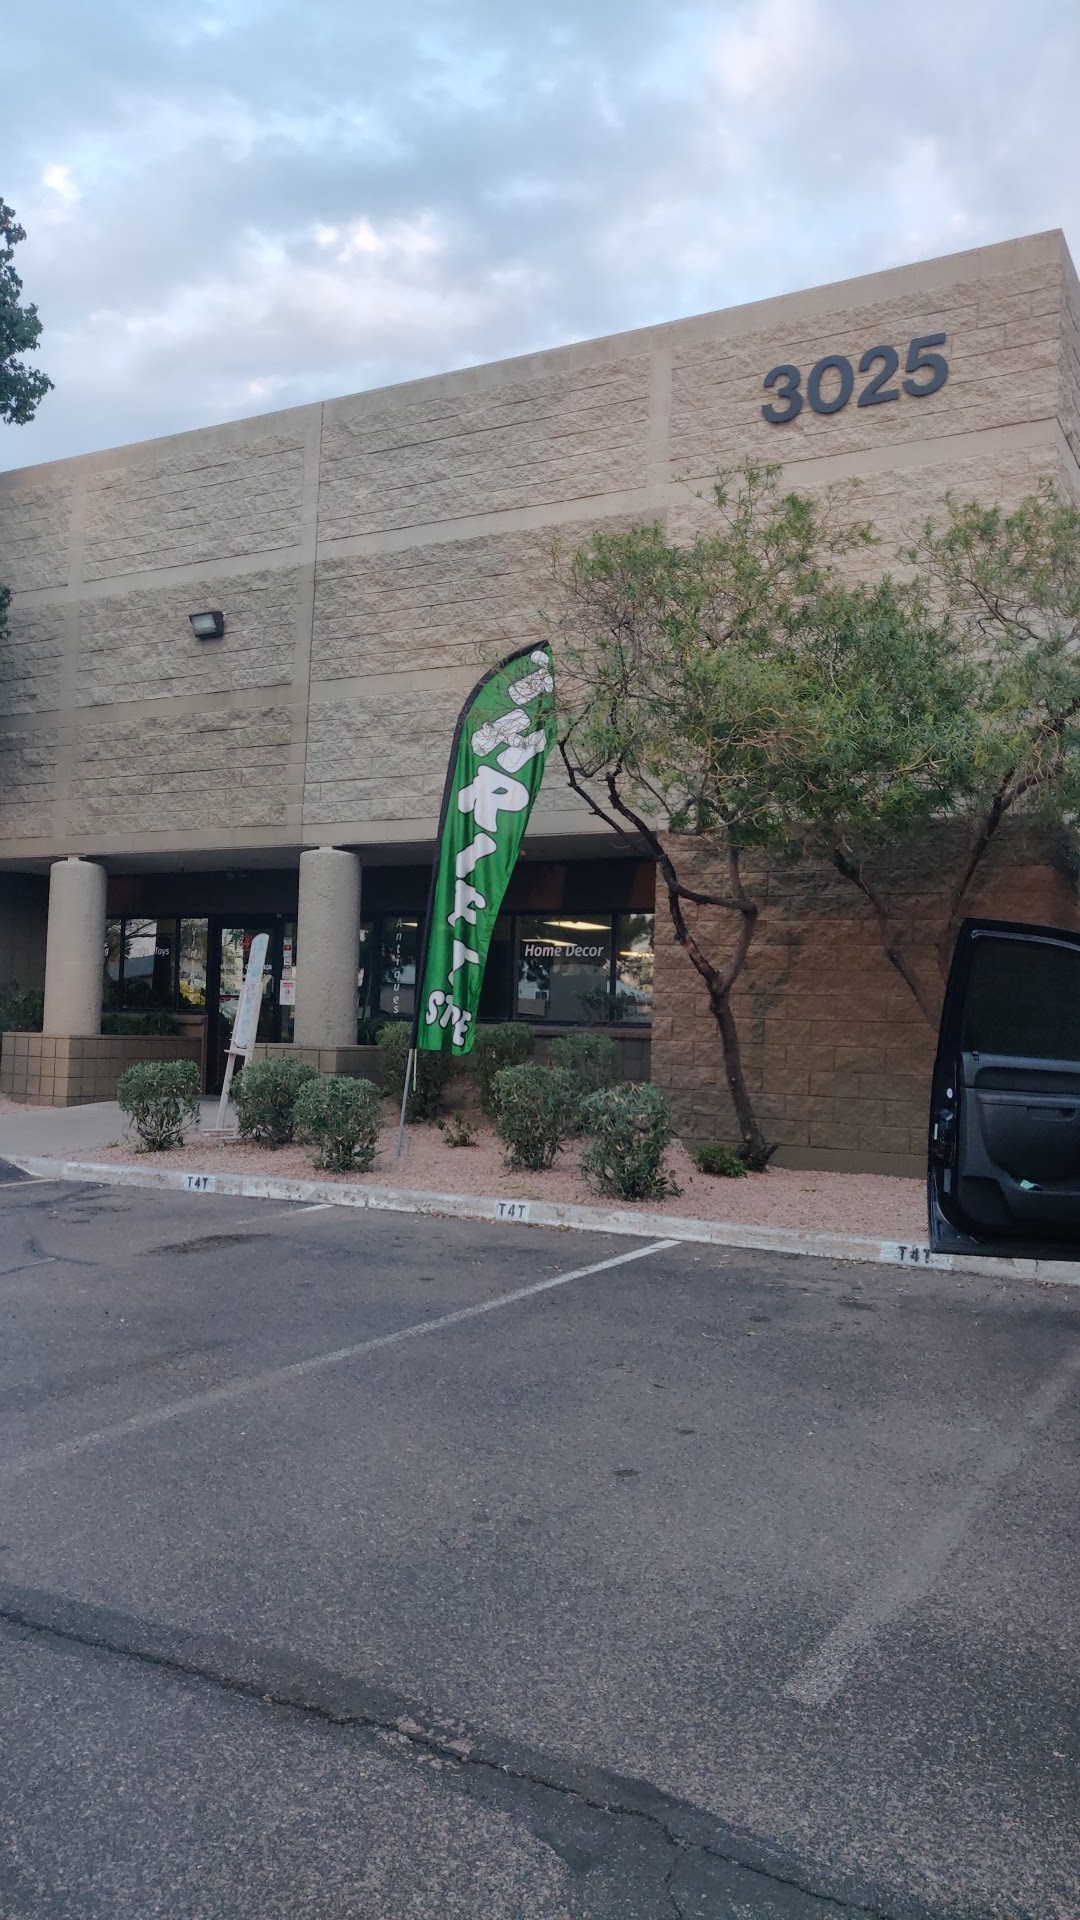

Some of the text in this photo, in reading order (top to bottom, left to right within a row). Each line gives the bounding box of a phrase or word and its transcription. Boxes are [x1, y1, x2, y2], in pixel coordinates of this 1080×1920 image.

[761, 332, 949, 424] 3025
[155, 946, 170, 957] Toys
[525, 944, 604, 957] Home Decor
[393, 918, 402, 1014] Antiques
[187, 1176, 209, 1190] T4T
[498, 1203, 526, 1218] T4T
